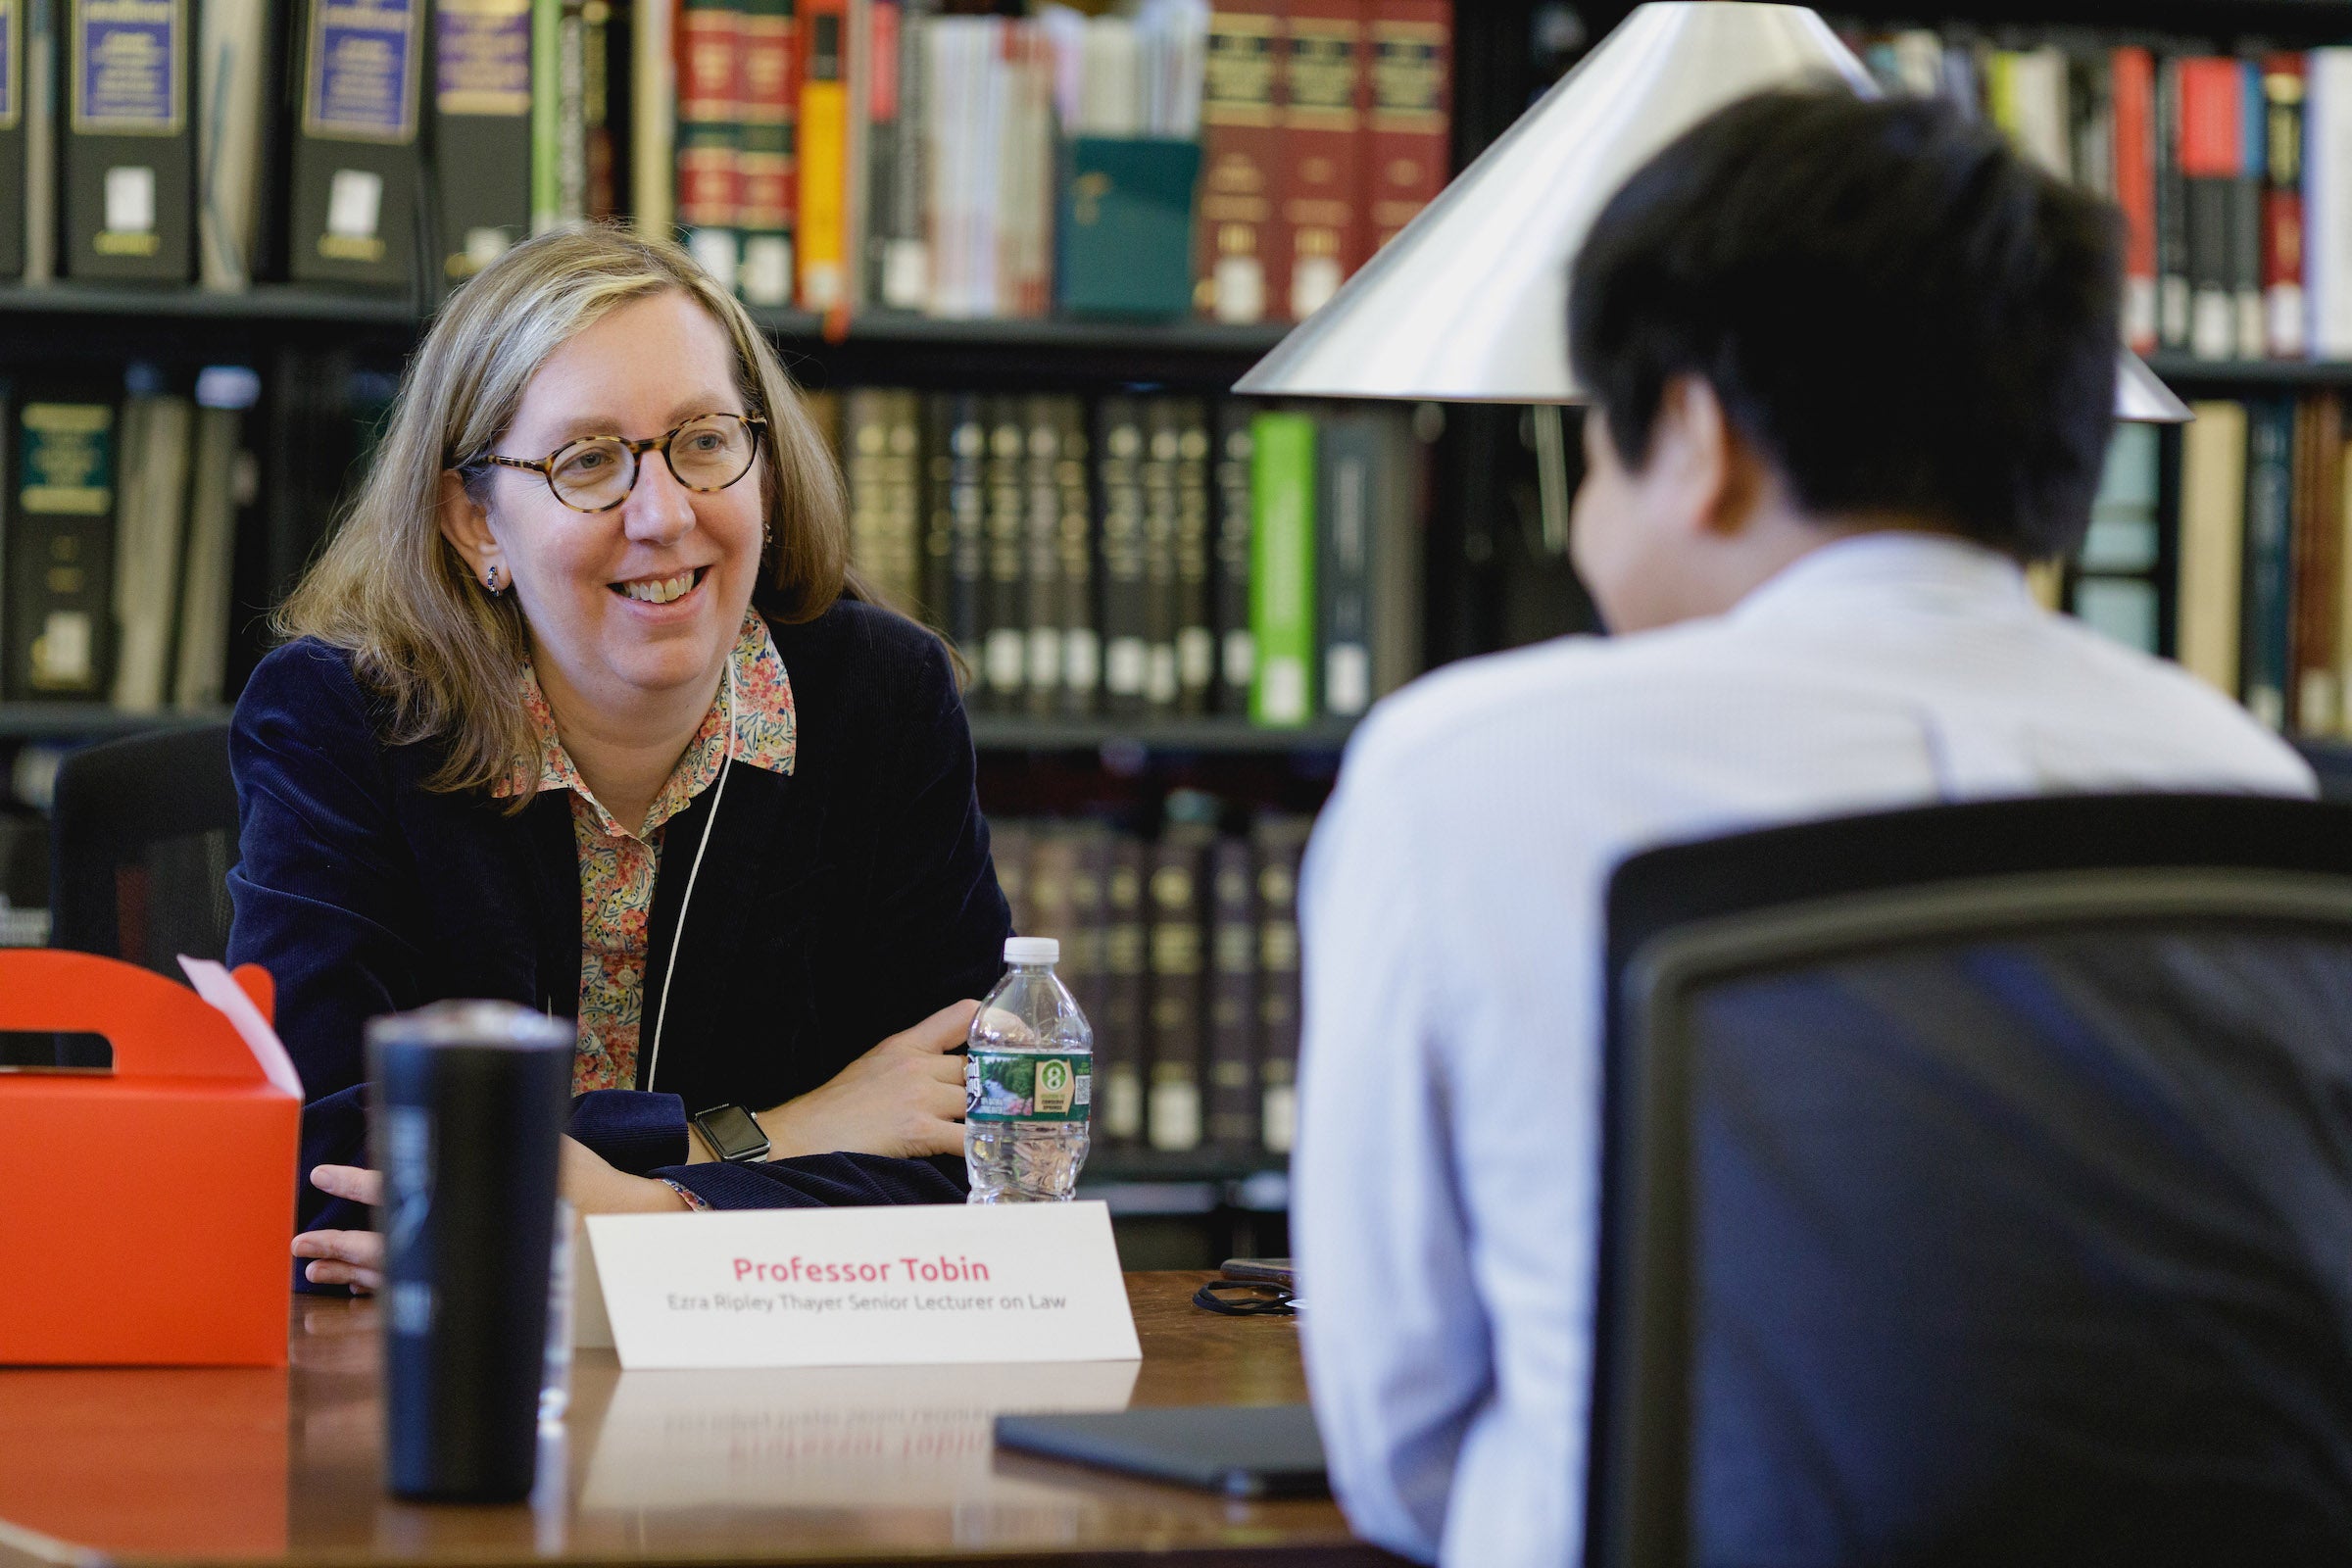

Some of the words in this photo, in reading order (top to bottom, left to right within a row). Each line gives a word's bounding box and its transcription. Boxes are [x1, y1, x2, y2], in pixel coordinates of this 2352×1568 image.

[732, 1255, 891, 1283] Professor
[899, 1255, 991, 1282] Tobin
[666, 1294, 710, 1311] Ezra
[714, 1293, 774, 1312] Ripley
[780, 1294, 843, 1312] Thayer
[848, 1293, 908, 1311] Senior
[914, 1294, 995, 1310] Lecturer
[1000, 1296, 1025, 1310] on
[1028, 1293, 1067, 1309] Law
